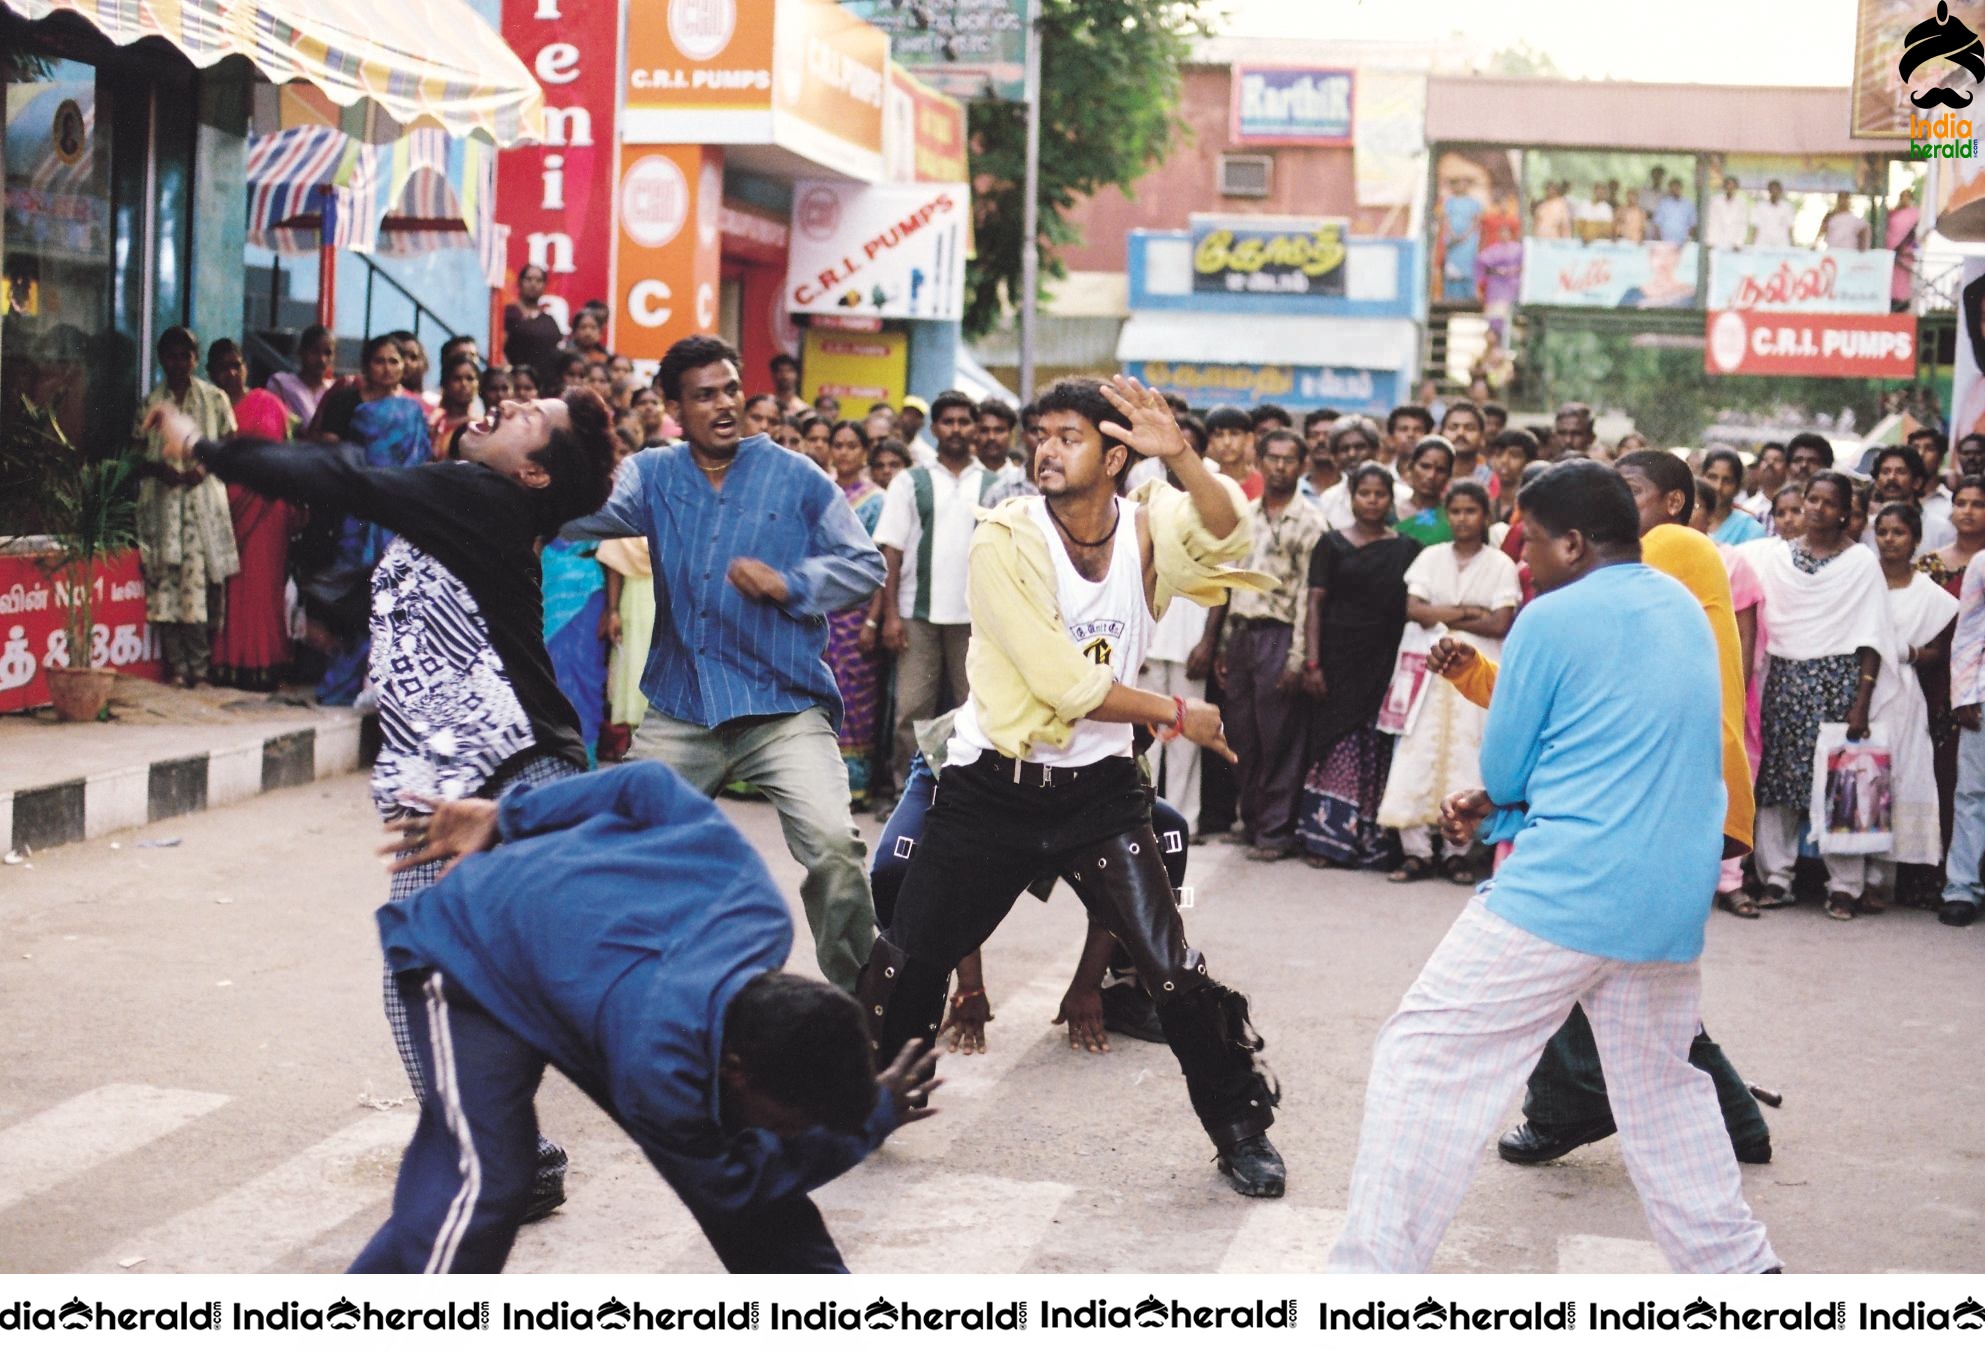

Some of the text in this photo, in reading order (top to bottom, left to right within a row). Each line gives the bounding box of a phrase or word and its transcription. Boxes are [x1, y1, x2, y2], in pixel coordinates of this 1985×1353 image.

[631, 69, 771, 90] C.R.I. PUMPS
[863, 193, 953, 261] PUMPS
[1751, 326, 1912, 360] C.R.I. PUMPS
